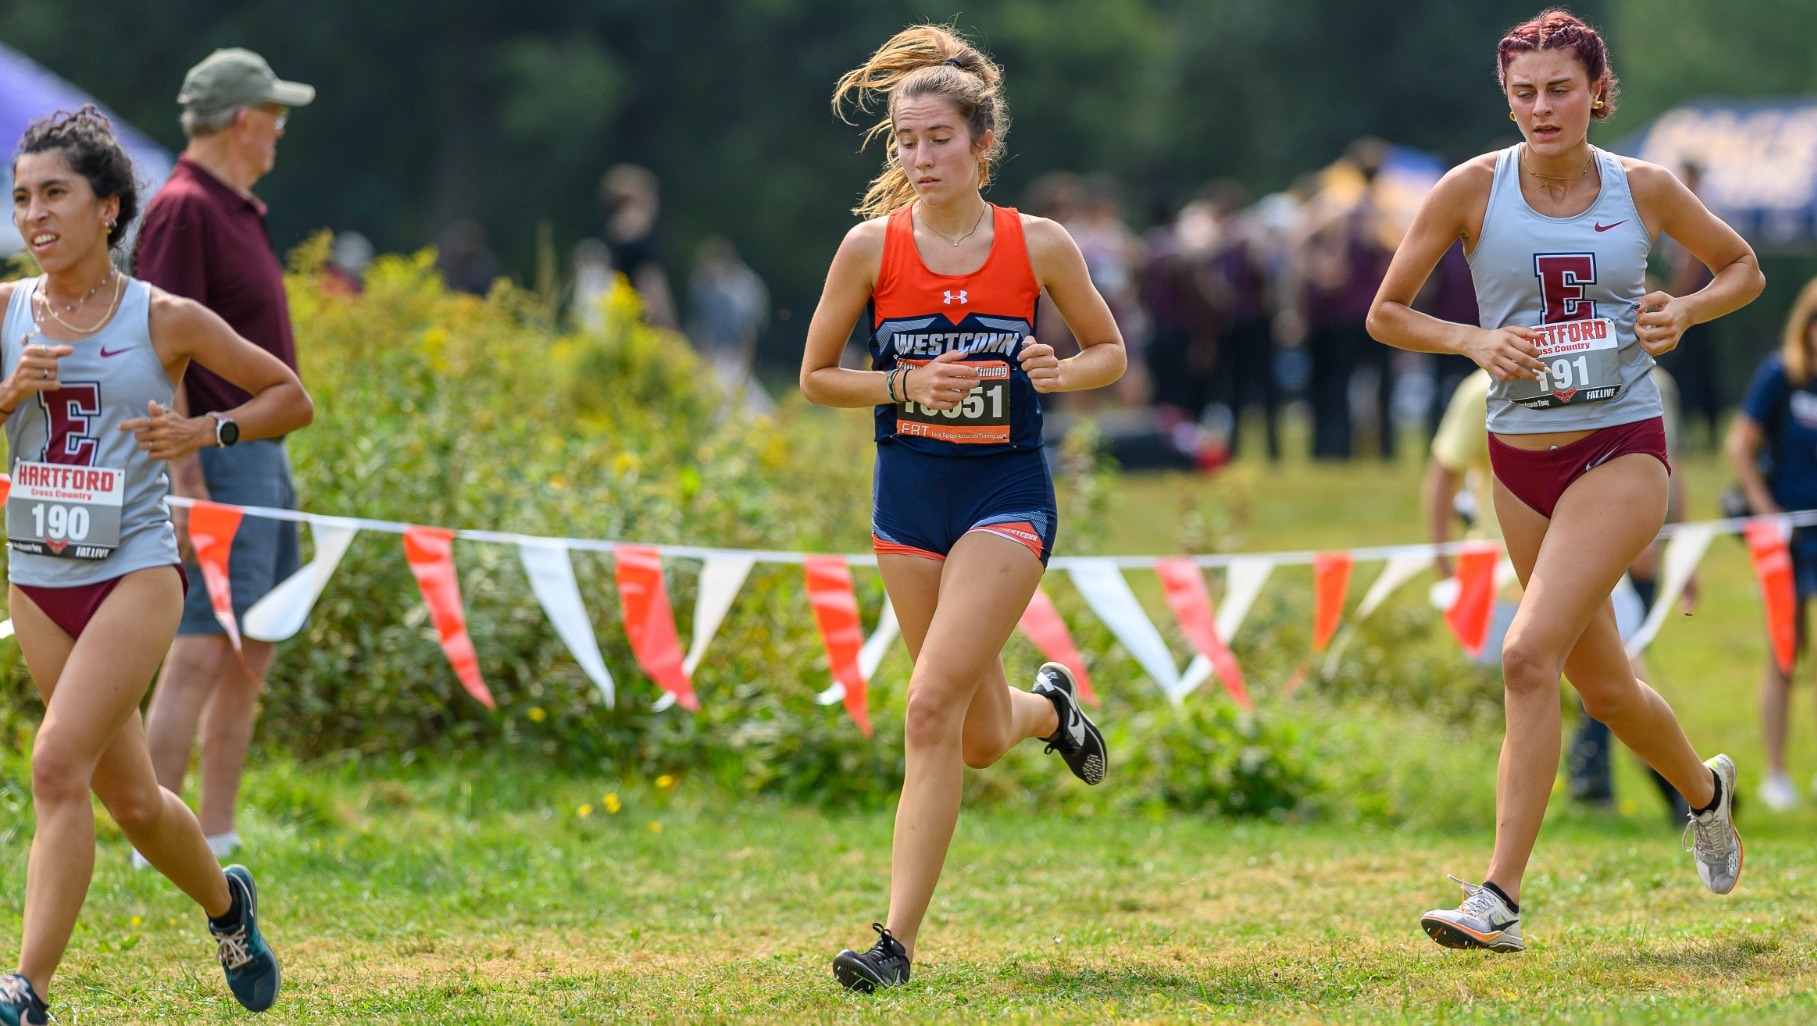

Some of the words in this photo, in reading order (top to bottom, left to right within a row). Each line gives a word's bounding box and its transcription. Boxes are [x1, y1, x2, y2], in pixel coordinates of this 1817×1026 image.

[1533, 252, 1597, 325] E
[893, 332, 1019, 356] WESTCONN
[1525, 321, 1607, 347] RTFORD
[1555, 342, 1590, 352] Country
[1532, 355, 1590, 392] 191
[37, 380, 101, 467] E
[18, 464, 114, 493] HARTFORD
[31, 488, 53, 497] Cross
[55, 490, 92, 500] Country
[32, 503, 90, 540] 190
